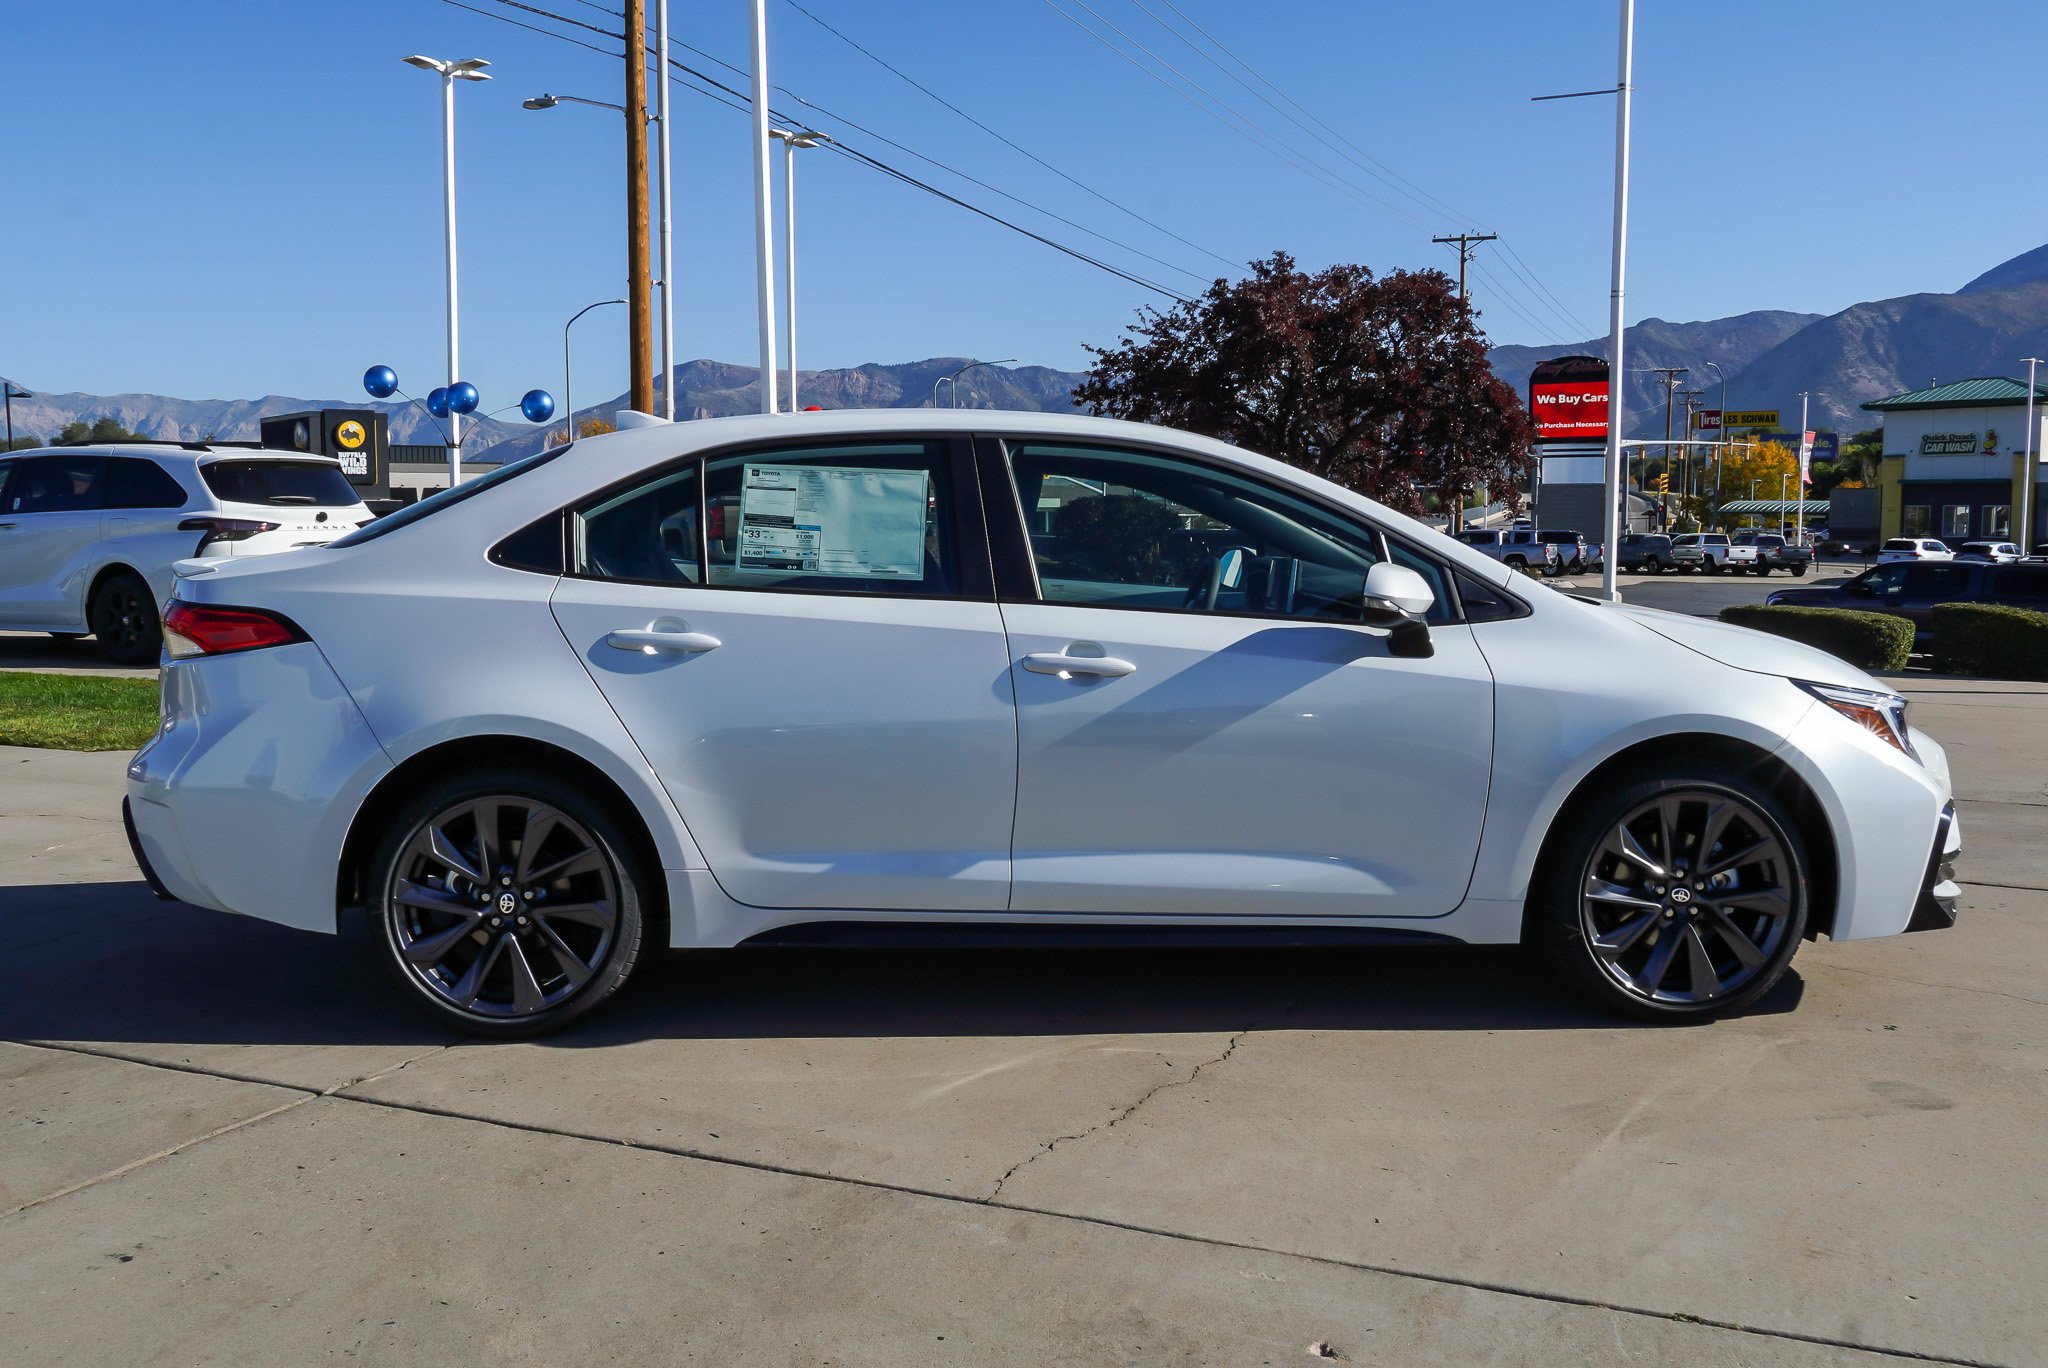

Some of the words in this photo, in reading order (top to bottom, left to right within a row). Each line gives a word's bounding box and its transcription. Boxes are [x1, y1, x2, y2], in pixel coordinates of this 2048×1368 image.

[1536, 394, 1556, 404] We
[1558, 394, 1580, 405] Buy
[1582, 393, 1608, 402] Cars
[1700, 412, 1720, 428] Tires
[1724, 415, 1738, 424] LES
[1741, 414, 1776, 424] SCHWAB
[1949, 433, 1977, 441] Quack
[1925, 442, 1944, 452] CAR
[1946, 441, 1975, 451] WASH
[339, 458, 367, 467] WILD
[748, 530, 761, 539] 33
